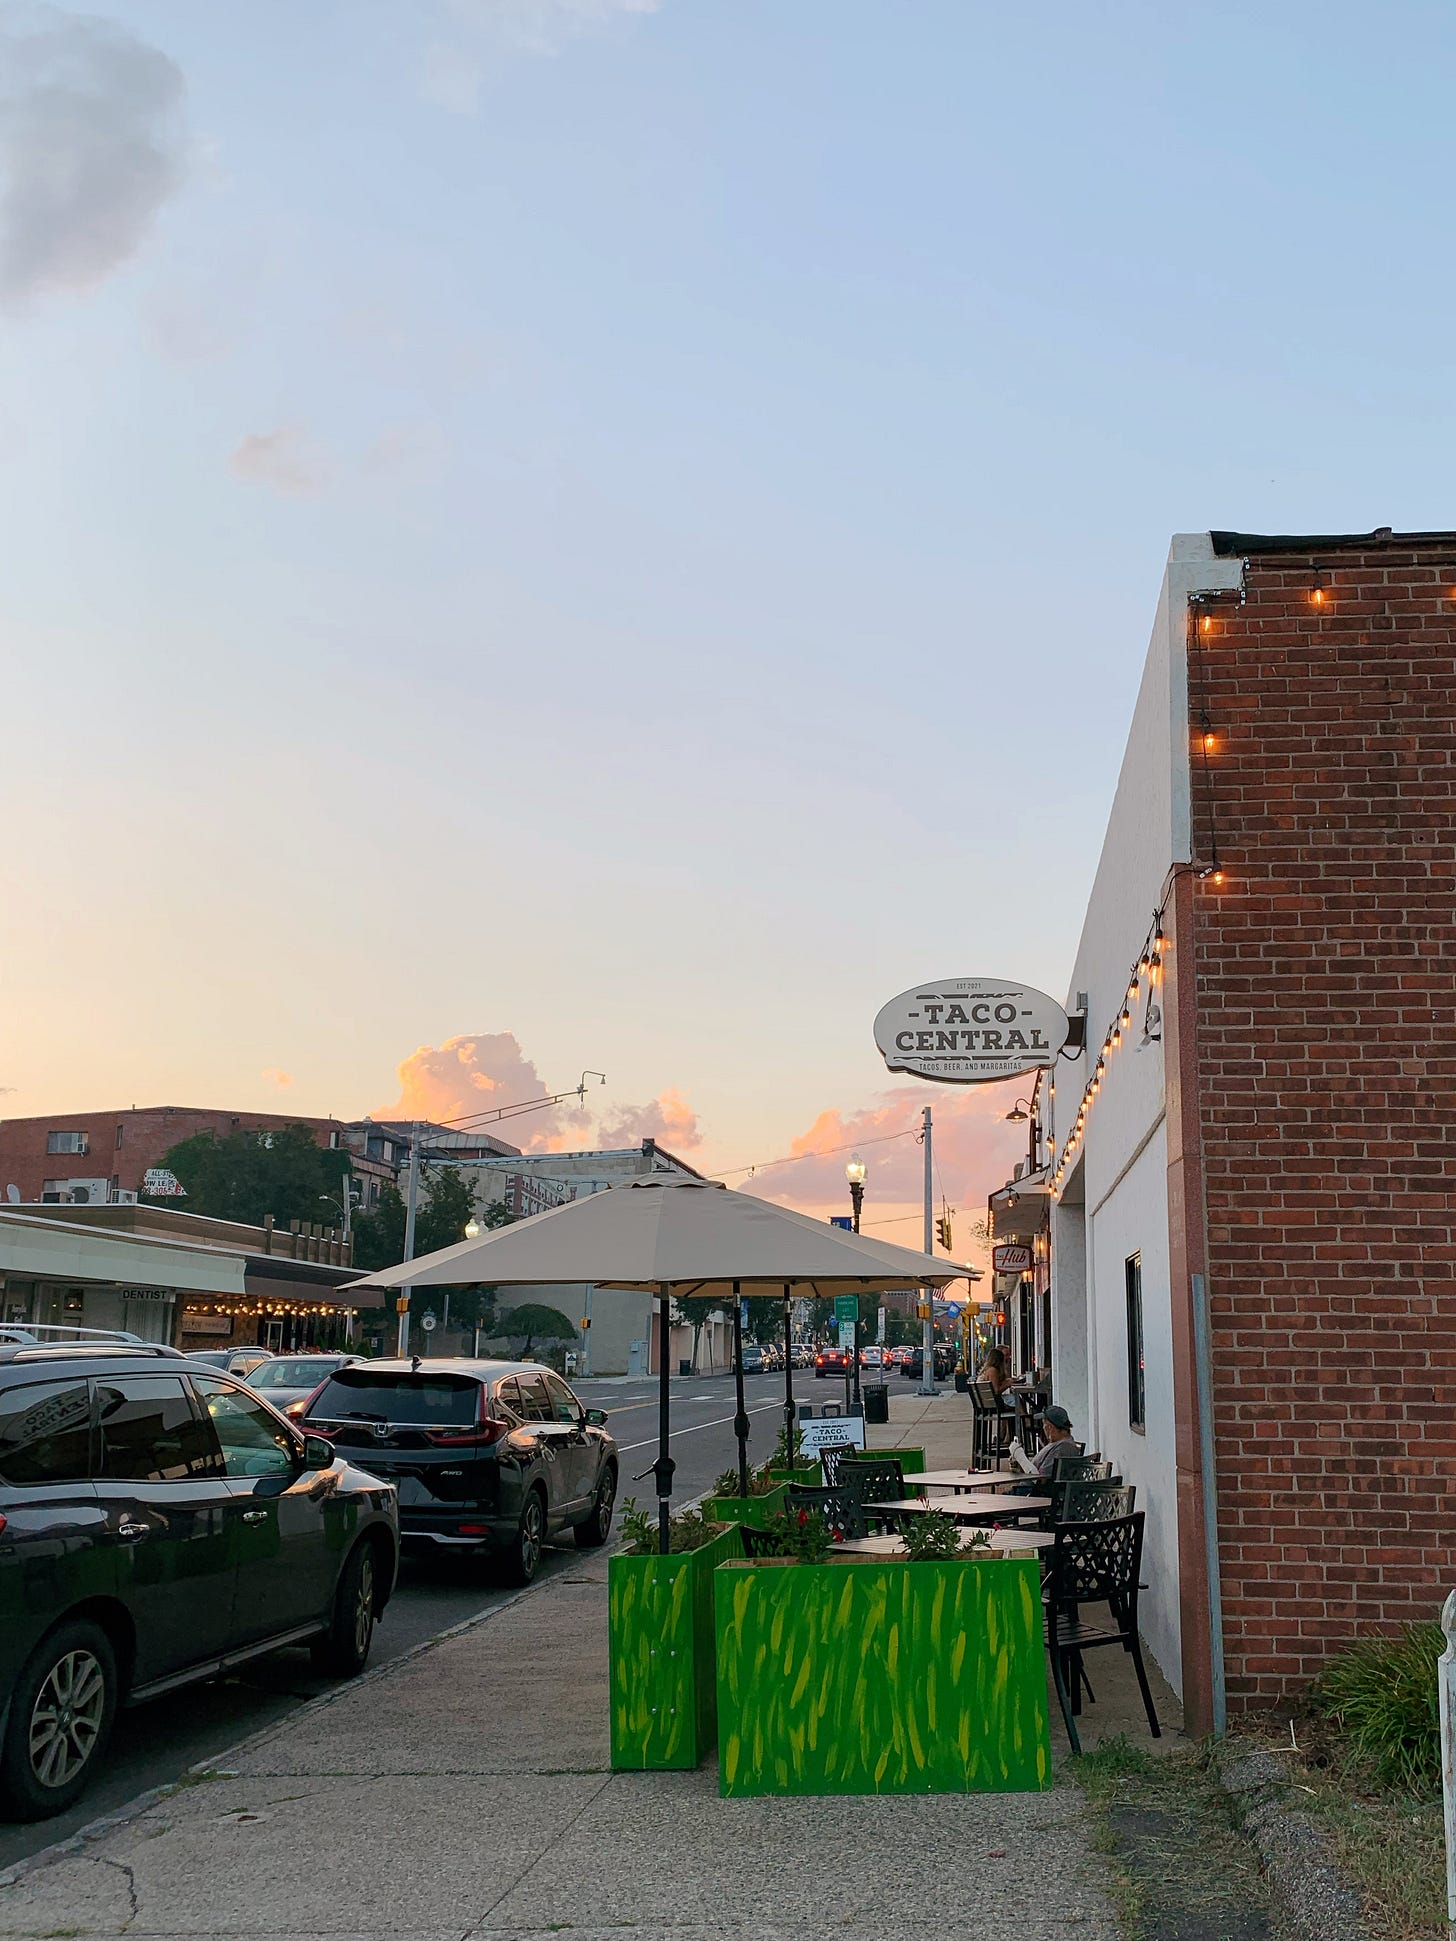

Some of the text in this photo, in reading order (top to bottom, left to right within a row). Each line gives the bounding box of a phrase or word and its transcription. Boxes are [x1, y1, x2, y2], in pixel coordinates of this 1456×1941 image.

[895, 1029, 1050, 1051] CENTRAL
[919, 1063, 942, 1071] TACOS,
[943, 1063, 962, 1071] BEER,
[980, 1062, 1022, 1070] MARGARITAS
[1001, 1248, 1027, 1266] Hub
[122, 1289, 167, 1300] DENTIST
[812, 1434, 850, 1442] CENTRAL
